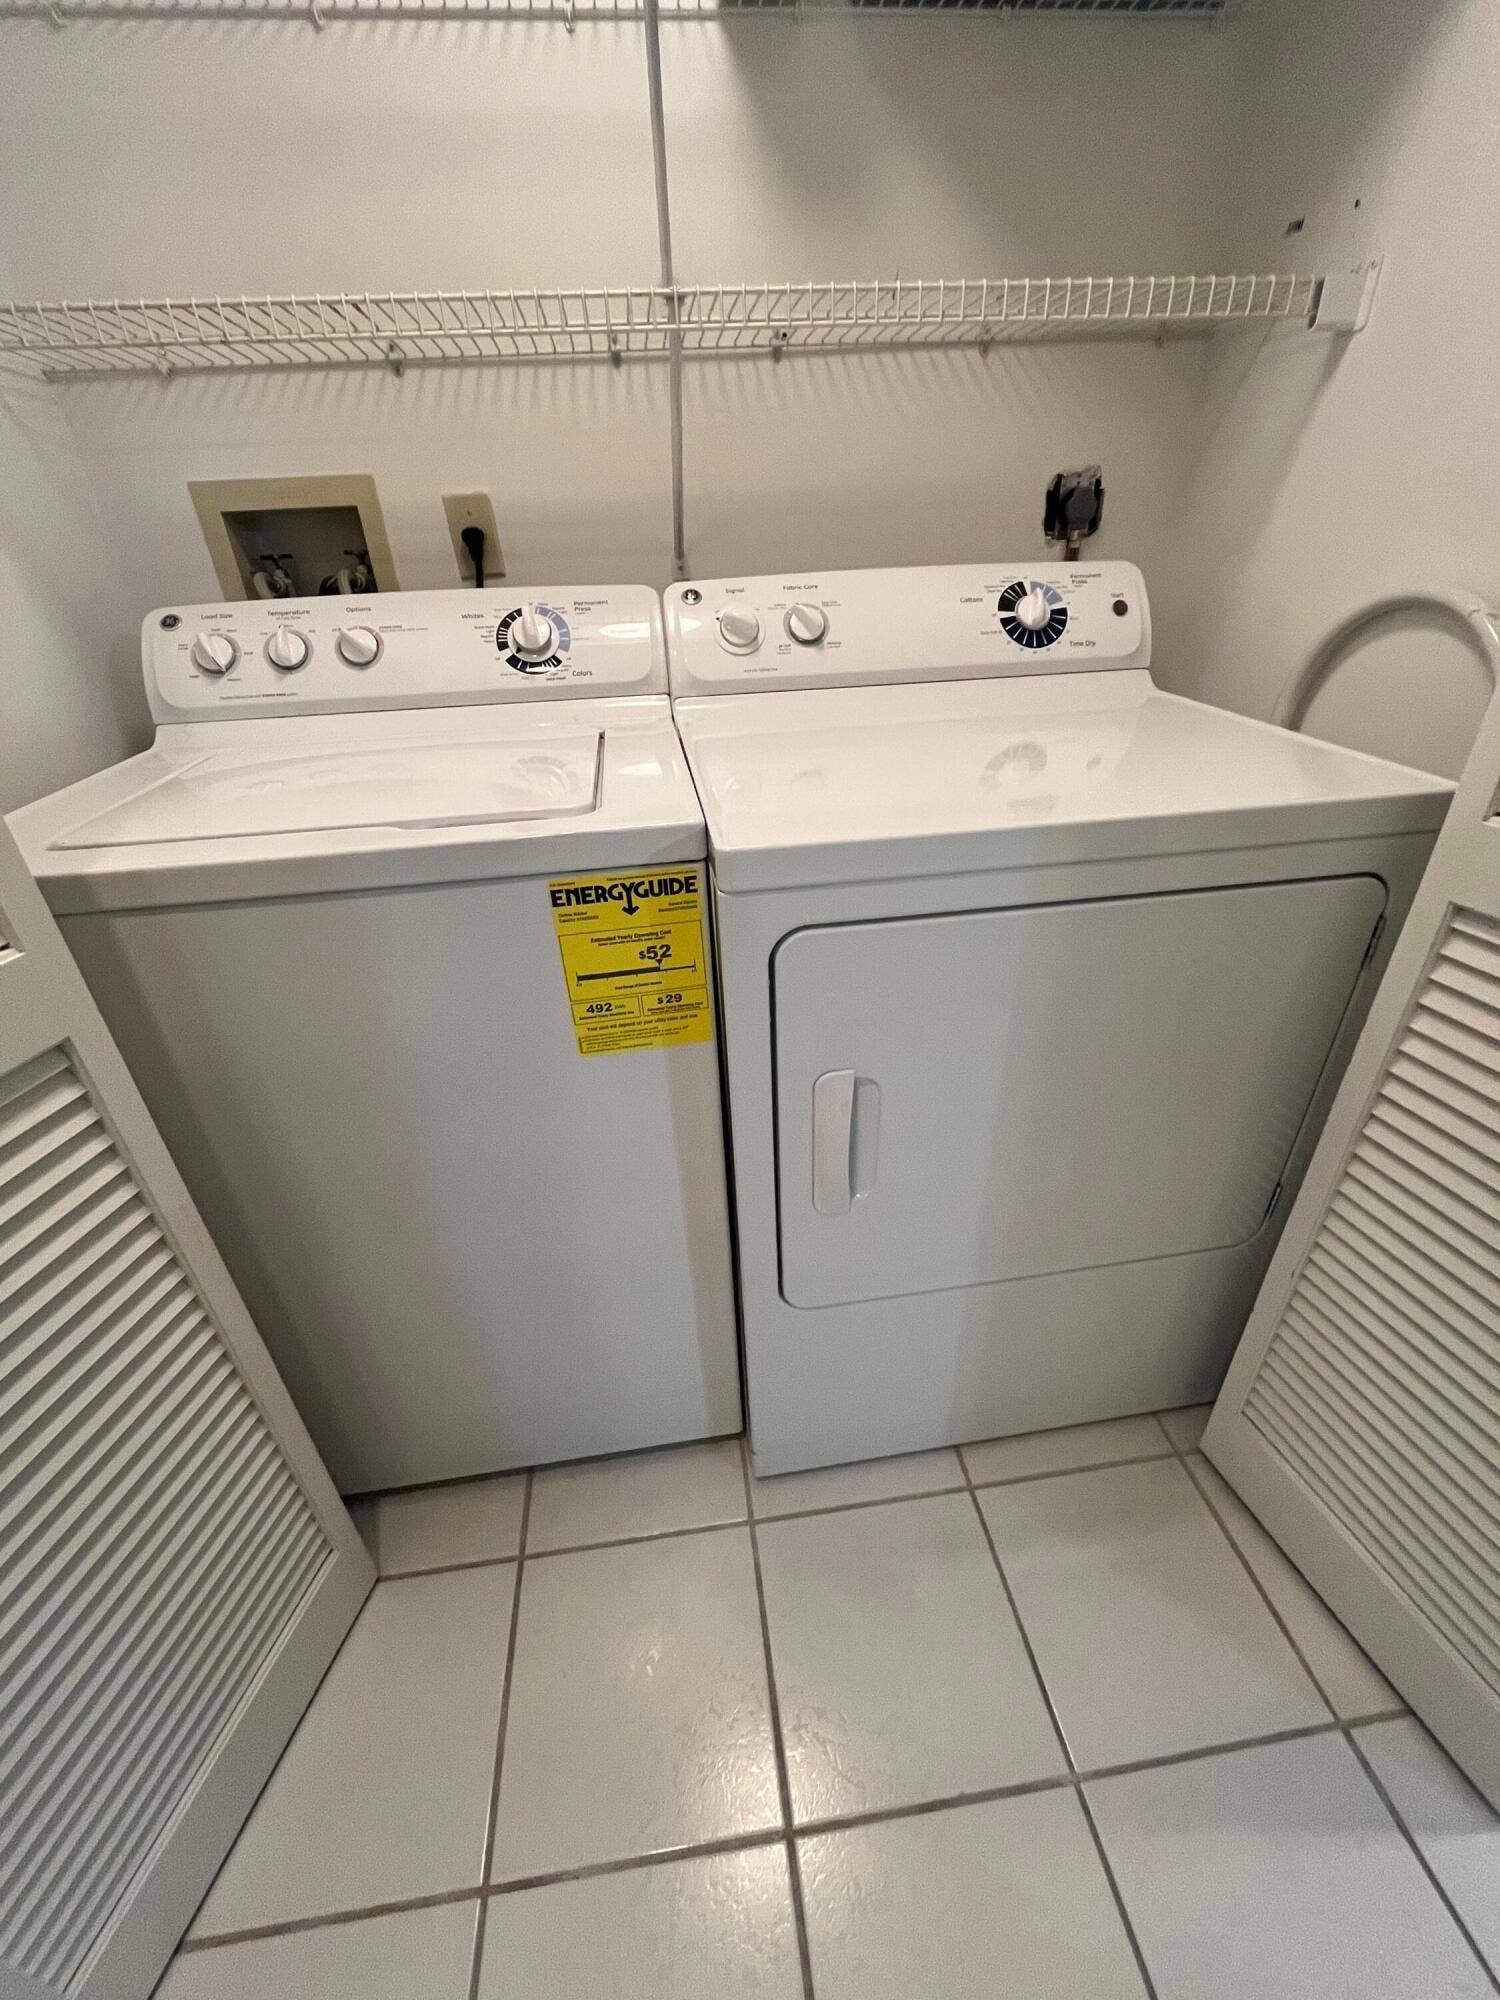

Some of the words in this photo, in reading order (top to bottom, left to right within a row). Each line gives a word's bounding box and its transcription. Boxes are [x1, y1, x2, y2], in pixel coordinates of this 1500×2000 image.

[267, 609, 310, 617] Temperature
[1085, 640, 1096, 648] Dry
[550, 875, 699, 908] ENERGYGUIDE
[590, 935, 616, 943] Estimated
[617, 933, 633, 941] Yearly
[634, 931, 659, 939] Operating
[638, 944, 672, 960] $52
[586, 1002, 613, 1014] 492
